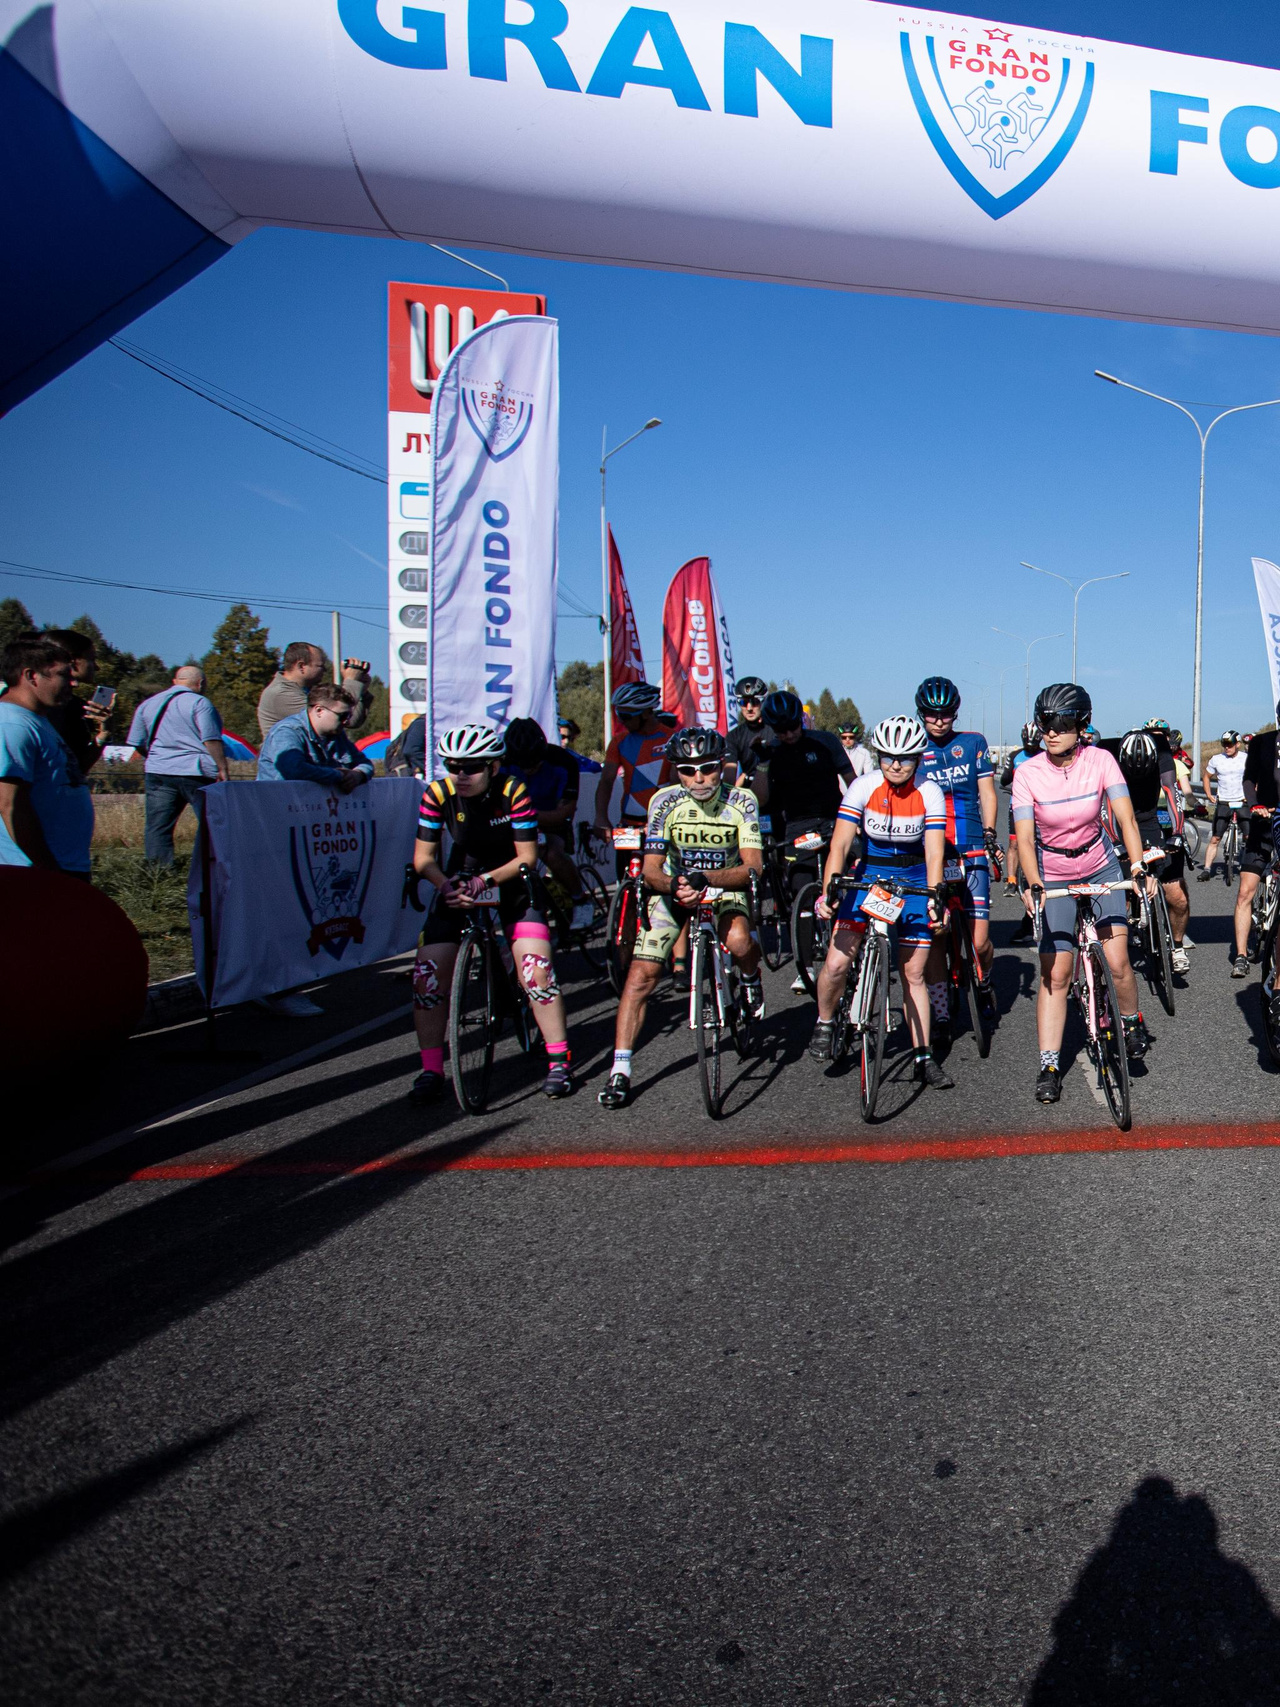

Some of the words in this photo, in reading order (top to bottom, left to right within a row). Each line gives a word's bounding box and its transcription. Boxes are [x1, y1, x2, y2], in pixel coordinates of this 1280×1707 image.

[899, 17, 969, 33] RUSSIA
[949, 39, 1049, 66] GRAN
[1027, 38, 1095, 53] РОССИЯ
[337, 0, 834, 129] GRAN
[950, 54, 1051, 83] FONDO
[480, 391, 516, 406] GRAN
[481, 400, 516, 414] FONDO
[482, 500, 512, 648] FONDO
[407, 608, 427, 624] 92
[926, 764, 970, 780] ALTAY
[312, 821, 357, 838] GRAN
[866, 818, 901, 834] Costa
[313, 838, 359, 856] FONDO
[685, 851, 722, 860] SAXO
[944, 868, 959, 879] 015
[870, 900, 895, 918] 2012
